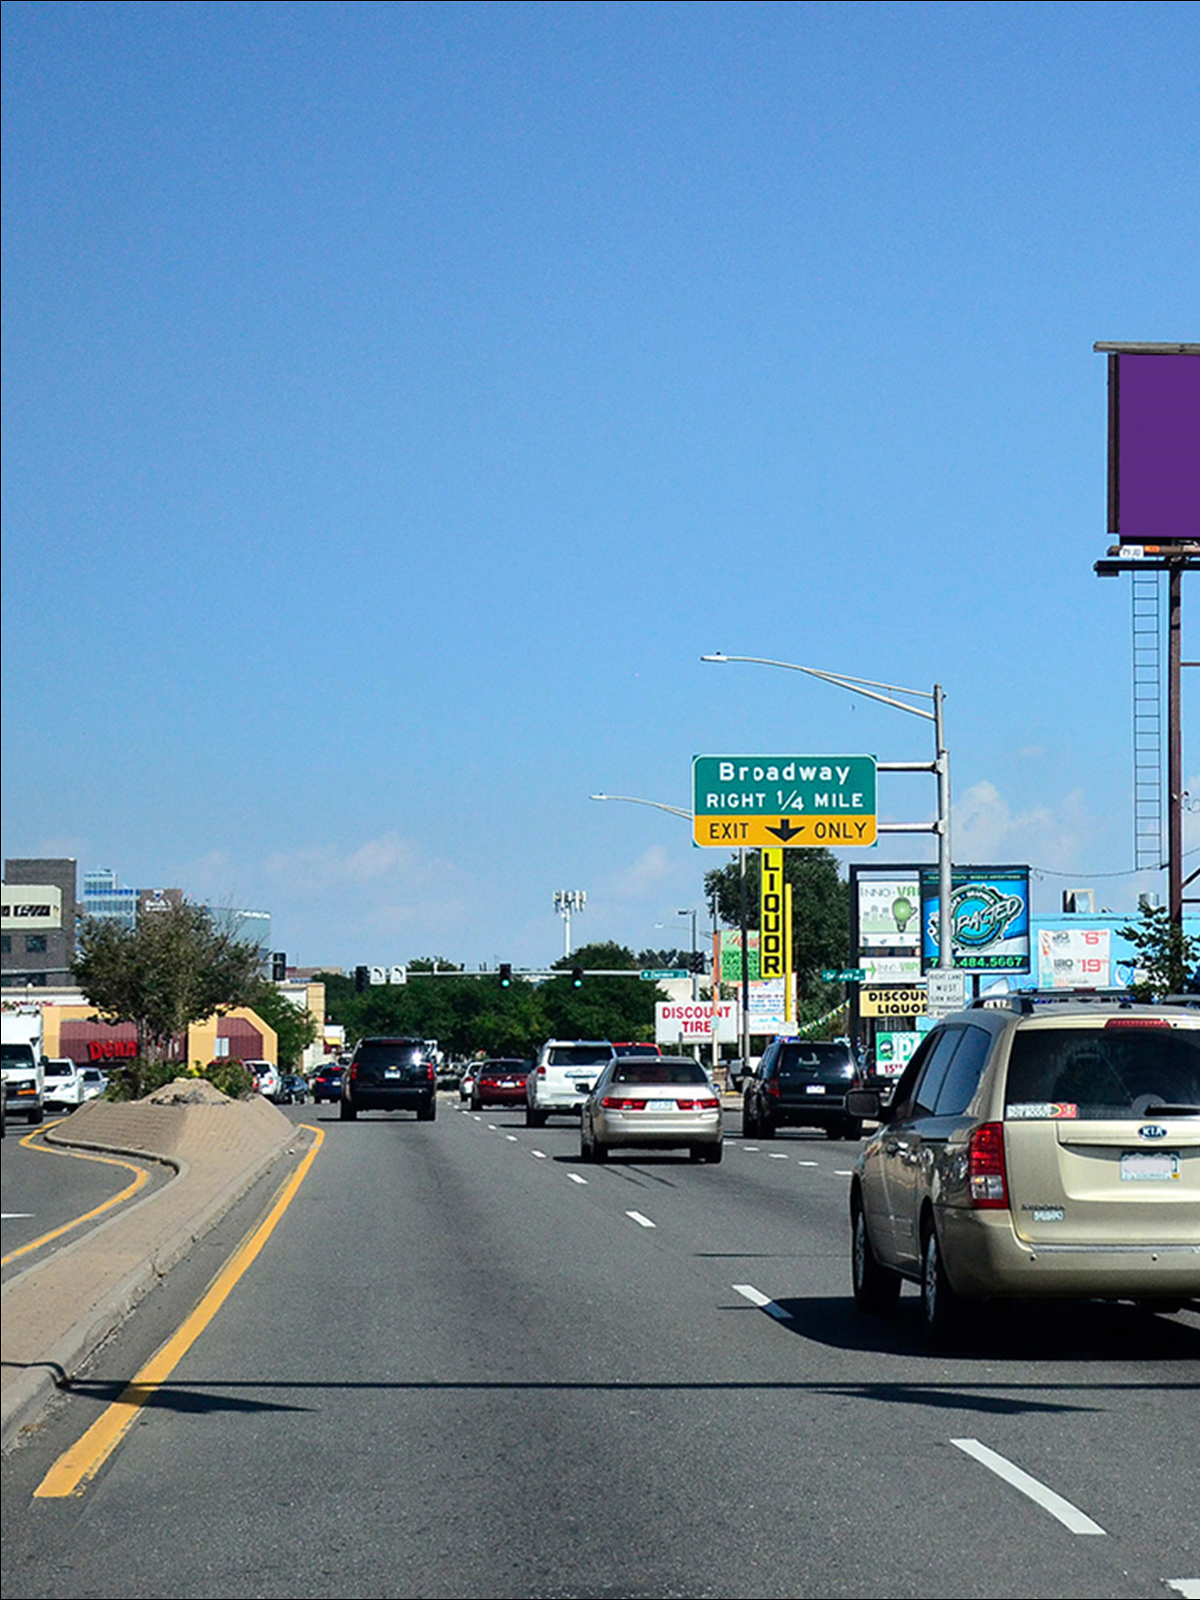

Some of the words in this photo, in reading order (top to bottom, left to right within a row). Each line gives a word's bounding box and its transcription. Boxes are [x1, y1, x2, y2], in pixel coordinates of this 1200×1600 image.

[719, 762, 850, 785] Broadway
[706, 793, 766, 808] RIGHT
[814, 793, 864, 808] MILE
[709, 822, 750, 839] EXIT
[814, 821, 867, 839] ONLY
[763, 852, 780, 974] LIQUOR
[930, 956, 1023, 968] 70.484.5667
[868, 991, 928, 1003] DISCOUN
[681, 1020, 712, 1033] TIRE
[88, 1040, 138, 1061] Denn
[1142, 1126, 1164, 1137] KIA
